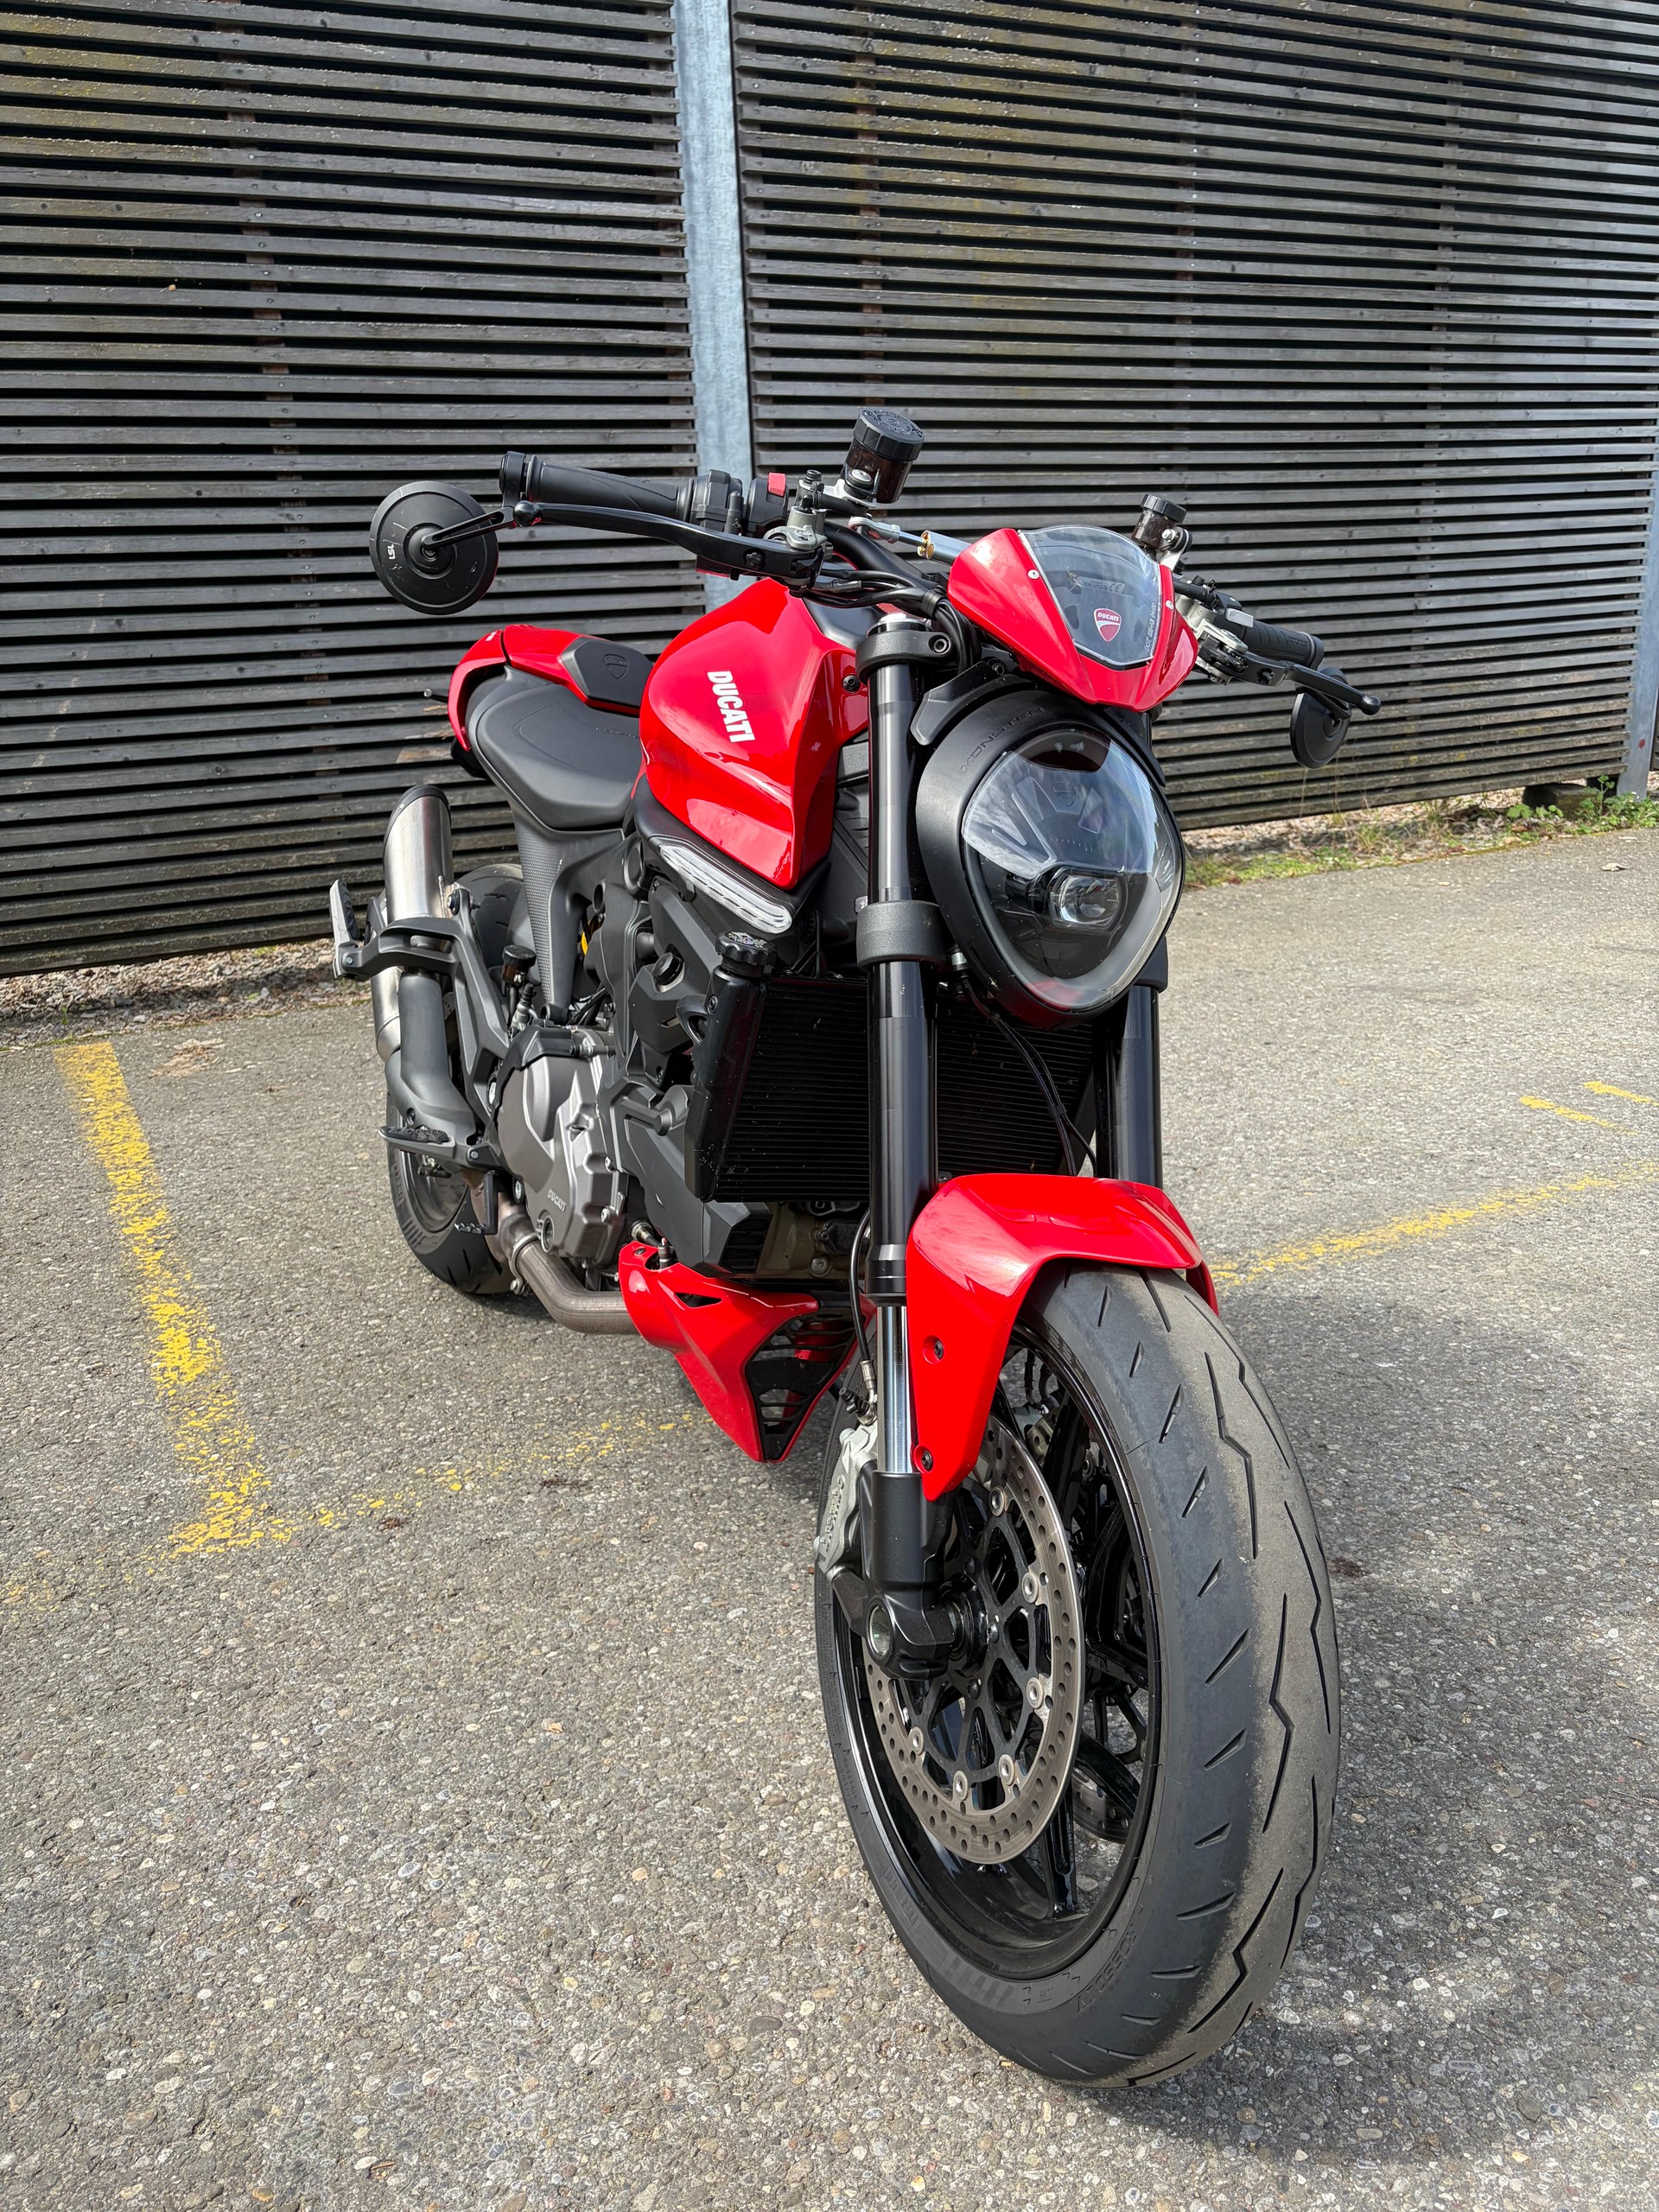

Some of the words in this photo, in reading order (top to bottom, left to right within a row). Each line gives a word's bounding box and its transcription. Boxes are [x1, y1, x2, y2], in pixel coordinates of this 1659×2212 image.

[1097, 612, 1120, 622] DUCATI
[707, 671, 756, 743] DUCATI
[960, 708, 1046, 774] MONSTER
[547, 1189, 567, 1212] DUCATI
